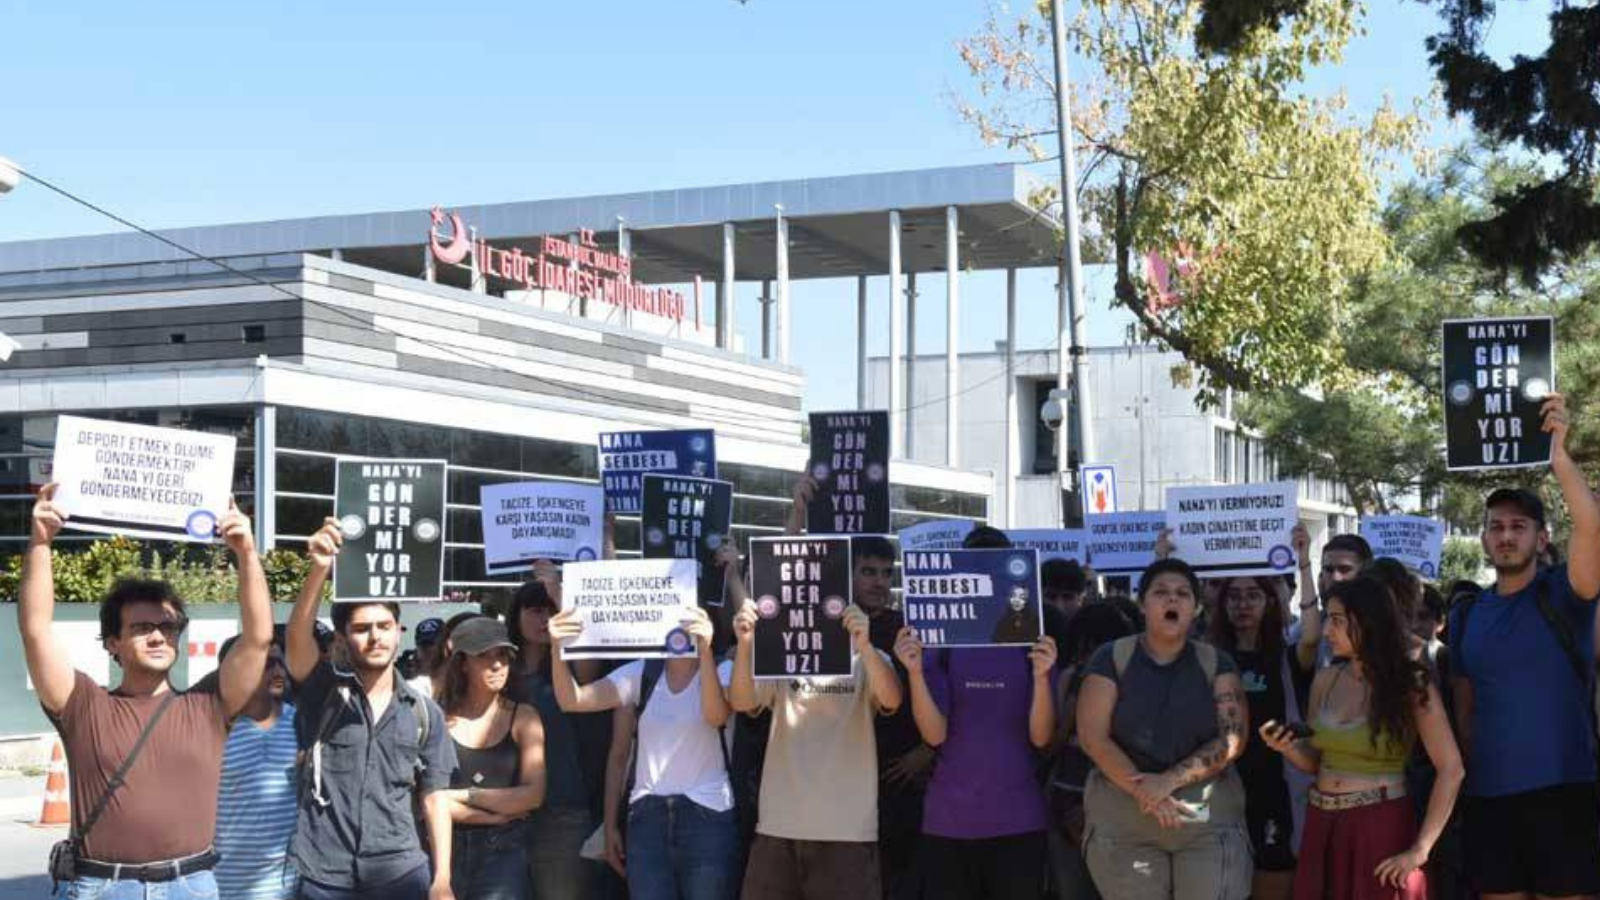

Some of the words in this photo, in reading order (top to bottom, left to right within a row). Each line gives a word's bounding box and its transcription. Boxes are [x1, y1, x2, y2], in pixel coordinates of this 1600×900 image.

[501, 247, 537, 291] GÖÇ
[540, 254, 598, 299] İDARESİ
[1468, 324, 1527, 339] NANA'YI
[1475, 343, 1520, 365] GÖN
[1476, 368, 1519, 389] DER
[1485, 387, 1512, 414] Mİ
[1477, 417, 1522, 439] YOR
[77, 430, 125, 450] DEPORT
[129, 437, 171, 454] ETMEK
[601, 433, 643, 449] NANA
[604, 453, 667, 469] SERBEST
[832, 452, 864, 470] DER
[363, 465, 422, 478] NANA'YI
[837, 470, 858, 490] Mİ
[369, 480, 413, 503] GÖN
[663, 481, 713, 496] NANA'YI
[668, 496, 705, 517] GÖN
[831, 494, 865, 512] YOR
[368, 506, 411, 527] DER
[668, 518, 702, 537] DER
[375, 527, 403, 550] Mİ
[675, 538, 697, 558] Mİ
[773, 543, 827, 556] NANA'YI
[366, 553, 411, 573] YOR
[781, 558, 821, 582] GÖN
[906, 552, 953, 570] NANA
[781, 585, 820, 605] DER
[908, 578, 980, 595] SERBEST
[789, 604, 815, 629] Mİ
[908, 602, 978, 621] BIRAKIL
[782, 631, 823, 651] YOR
[802, 682, 855, 695] Columbia
